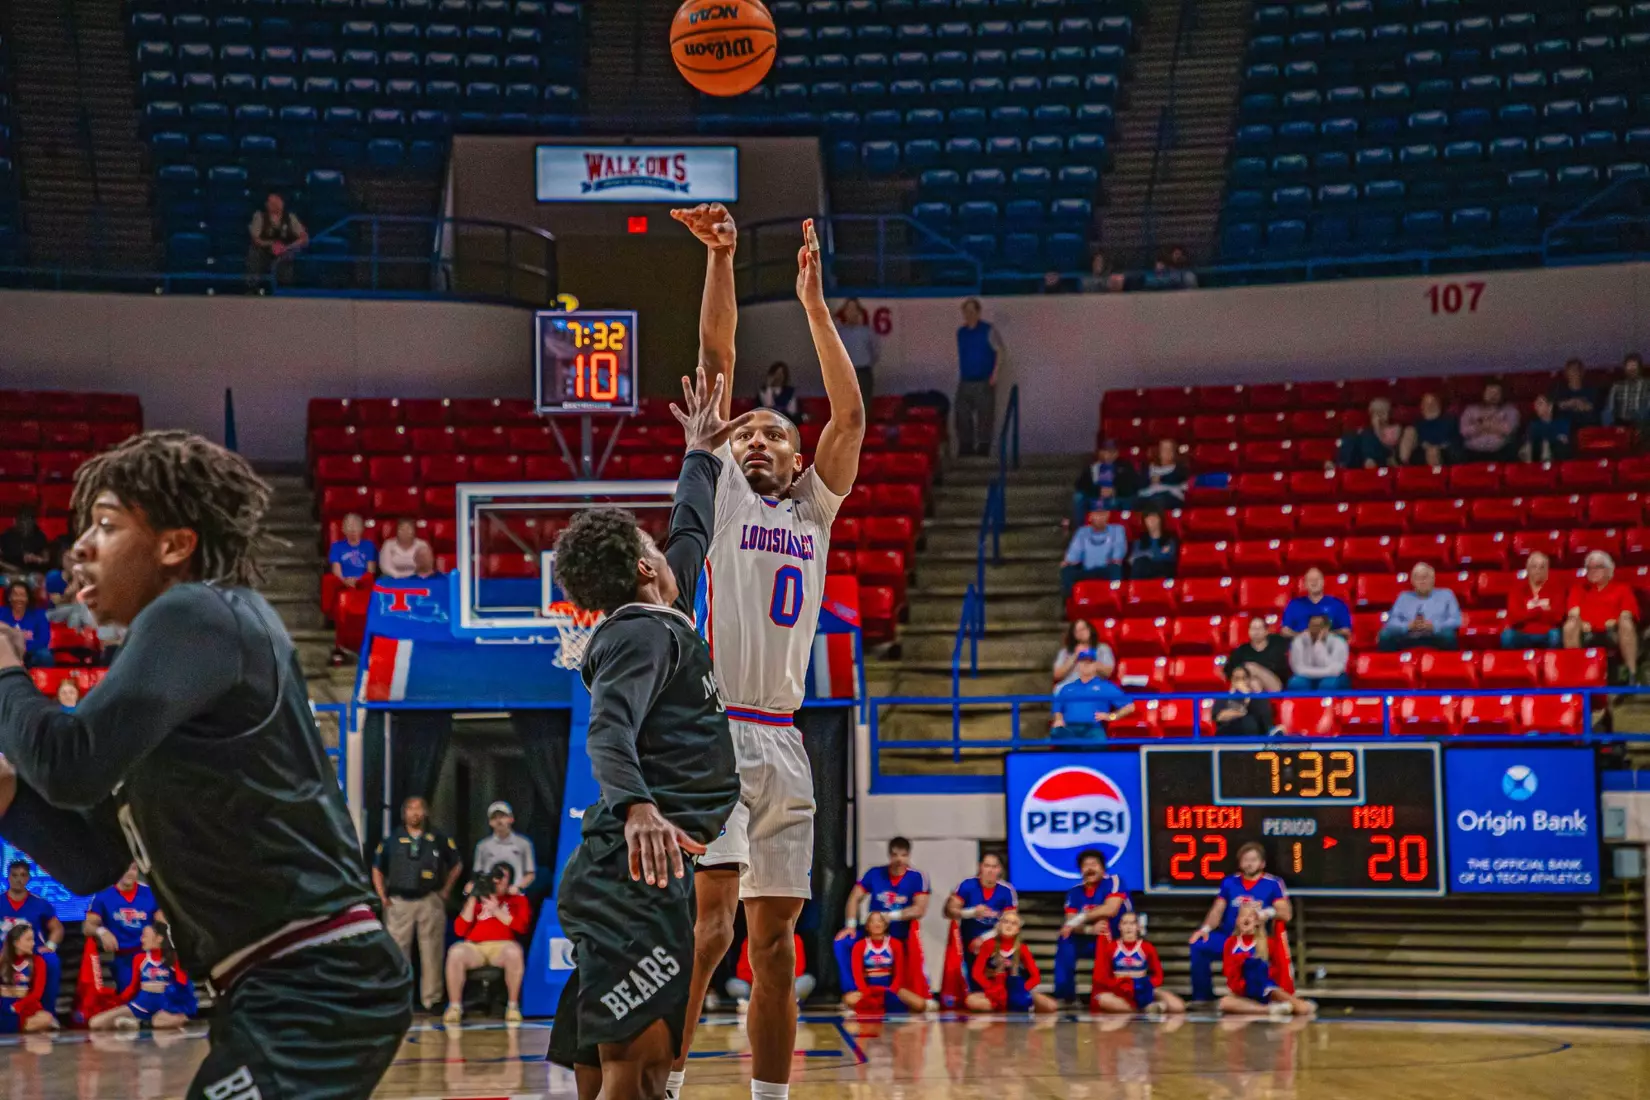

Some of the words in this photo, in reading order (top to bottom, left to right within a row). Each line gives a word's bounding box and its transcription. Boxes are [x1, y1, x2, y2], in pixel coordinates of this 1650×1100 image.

[689, 5, 738, 24] NCAA
[684, 37, 754, 60] Wilson
[1424, 281, 1487, 315] 107
[566, 321, 626, 350] 7:32
[575, 353, 618, 400] 10
[769, 564, 804, 628] 0
[1255, 751, 1355, 797] 7:32
[1027, 811, 1125, 834] PEPSI
[1166, 805, 1242, 829] LATECH
[1263, 818, 1316, 836] PERIOD
[1352, 805, 1394, 829] MSU
[1457, 809, 1526, 836] Origin
[1532, 808, 1588, 832] Bank
[1170, 834, 1227, 880] 22
[1292, 842, 1303, 873] 1
[1367, 834, 1428, 881] 20
[1467, 858, 1491, 871] THE
[1493, 858, 1544, 871] OFFICIAL
[1548, 858, 1583, 871] BANK
[1459, 872, 1476, 884] OF
[1478, 872, 1494, 884] LA
[1496, 872, 1529, 884] TECH
[1530, 872, 1592, 884] ATHLETICS
[600, 946, 681, 1020] BEARS
